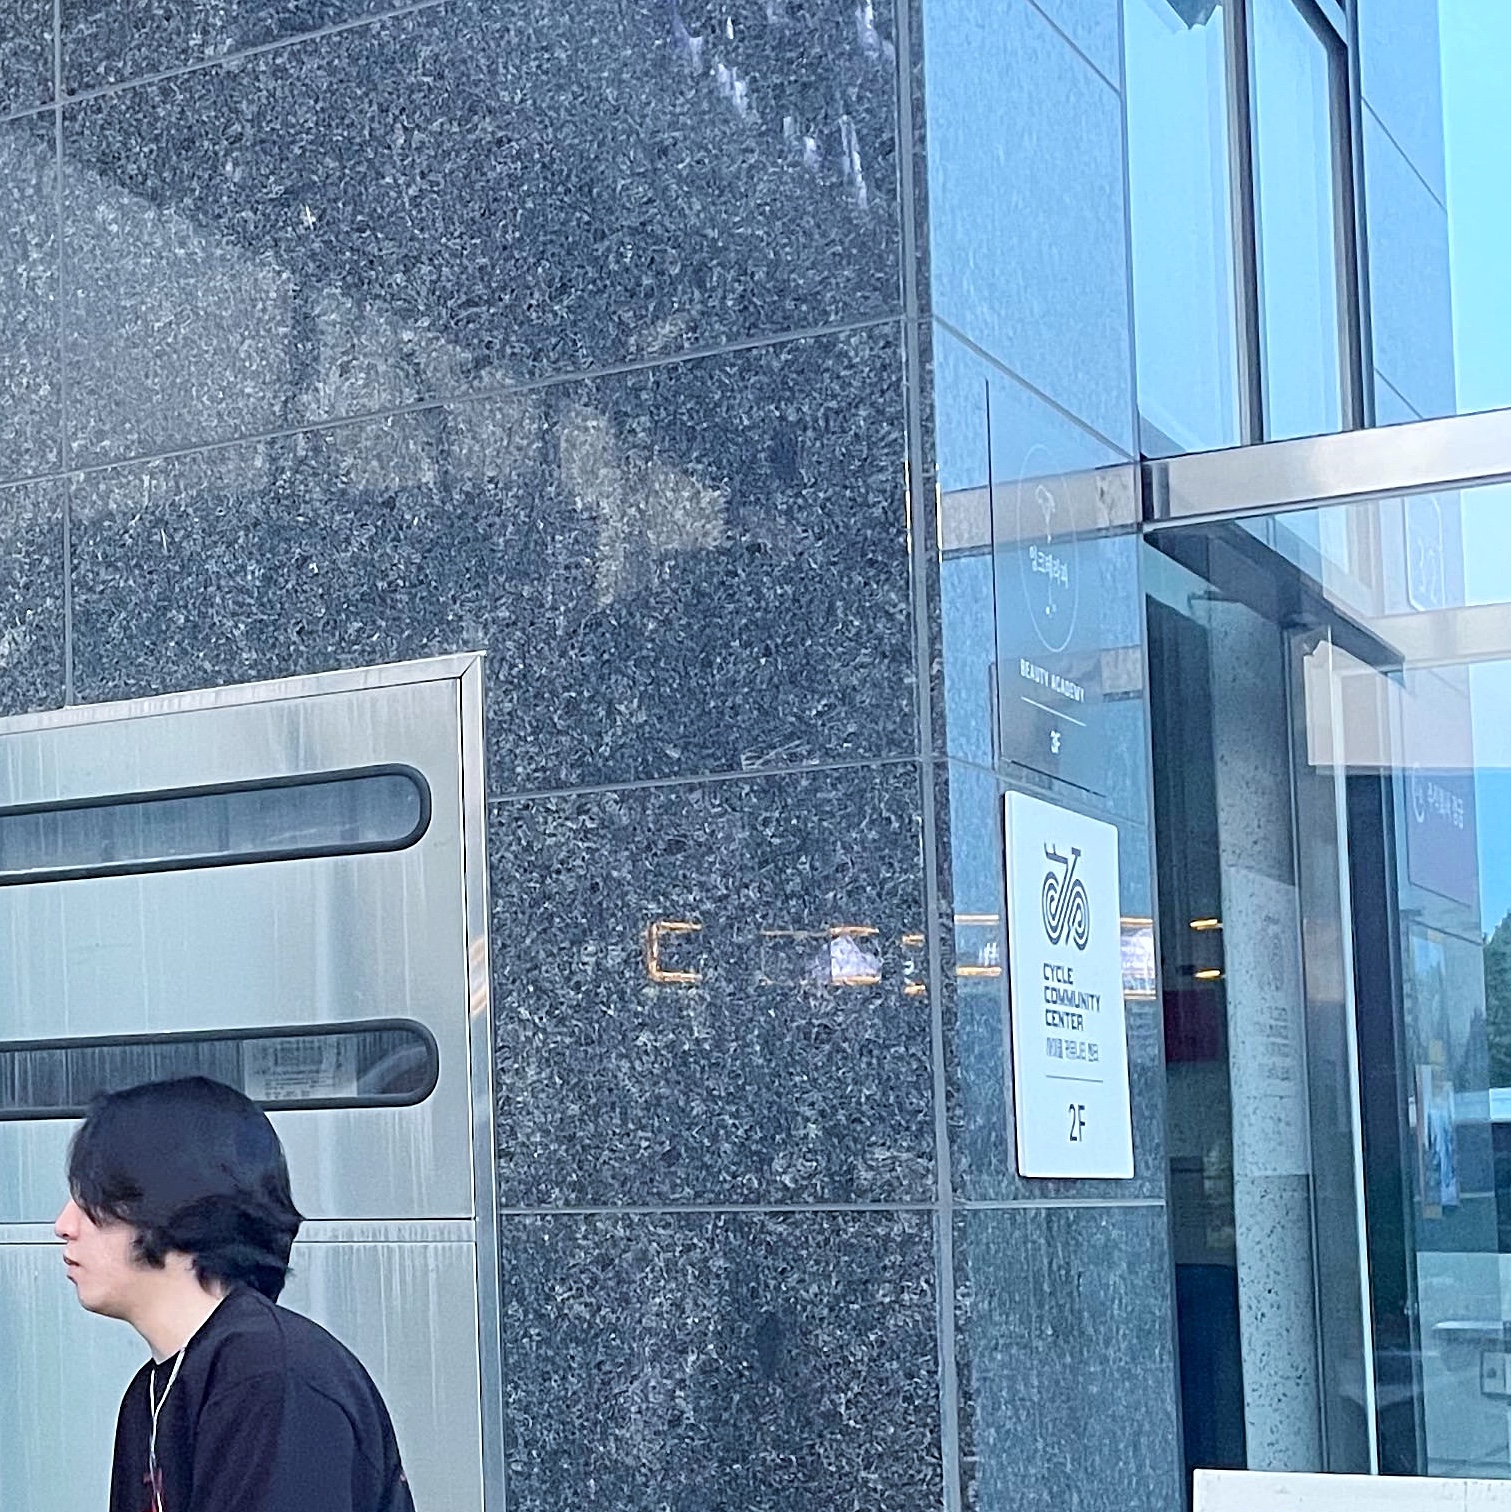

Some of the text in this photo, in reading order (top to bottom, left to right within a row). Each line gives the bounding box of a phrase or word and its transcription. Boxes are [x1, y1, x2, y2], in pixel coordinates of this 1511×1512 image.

[1043, 963, 1073, 984] CYCLE
[1044, 986, 1101, 1013] COMMUNITY
[1045, 1009, 1084, 1032] CENTER
[1068, 1103, 1086, 1142] 2F
